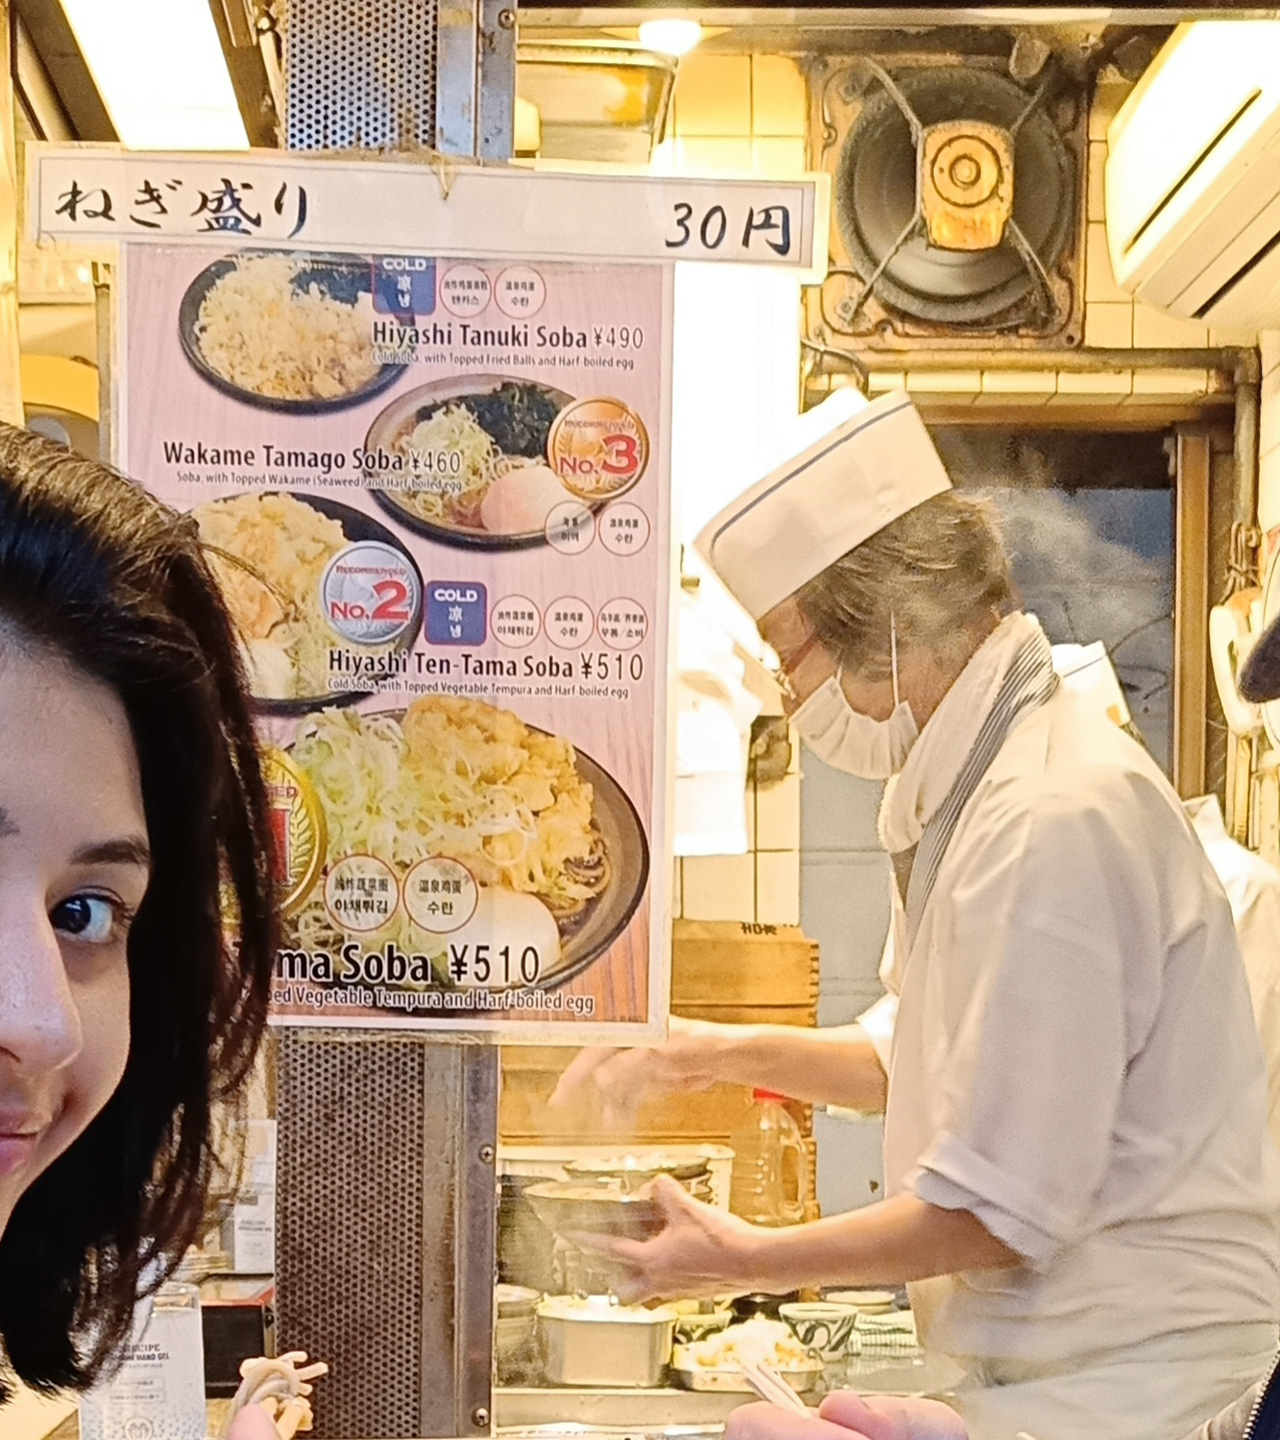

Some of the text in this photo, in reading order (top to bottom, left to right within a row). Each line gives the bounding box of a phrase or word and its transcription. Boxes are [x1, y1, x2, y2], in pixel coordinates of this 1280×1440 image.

[55, 177, 791, 257] ねぎ盛り 30円
[382, 257, 427, 271] COLD
[372, 321, 644, 350] Hiyashi Tanuki Soba ¥490
[424, 352, 447, 364] with
[449, 352, 484, 367] Topped
[486, 353, 511, 365] Fried
[512, 354, 535, 366] Balls
[538, 355, 557, 367] and
[616, 358, 635, 370] egg
[163, 441, 462, 474] Wakame Tamago Soba ¥460
[559, 434, 639, 475] No.3
[206, 471, 229, 485] with
[231, 472, 266, 487] Topped
[268, 473, 312, 487] Wakame
[313, 473, 365, 488] (Seaweed)
[444, 480, 463, 493] egg
[330, 579, 410, 621] No.2
[433, 588, 479, 603] COLD
[328, 650, 644, 682] Hiyashi Ten-Tama Soba ¥510
[327, 678, 350, 691] Cold
[378, 679, 402, 692] with
[404, 680, 439, 694] Topped
[440, 680, 489, 695] Vegetable
[491, 683, 532, 698] Tempura
[534, 684, 553, 696] and
[610, 687, 629, 700] egg
[334, 898, 389, 915] 야채튀김
[427, 900, 454, 916] 수란
[274, 943, 540, 985] ma Soba ¥510
[271, 985, 595, 1015] ed Vegetable Tempura and Harf-boiled egg
